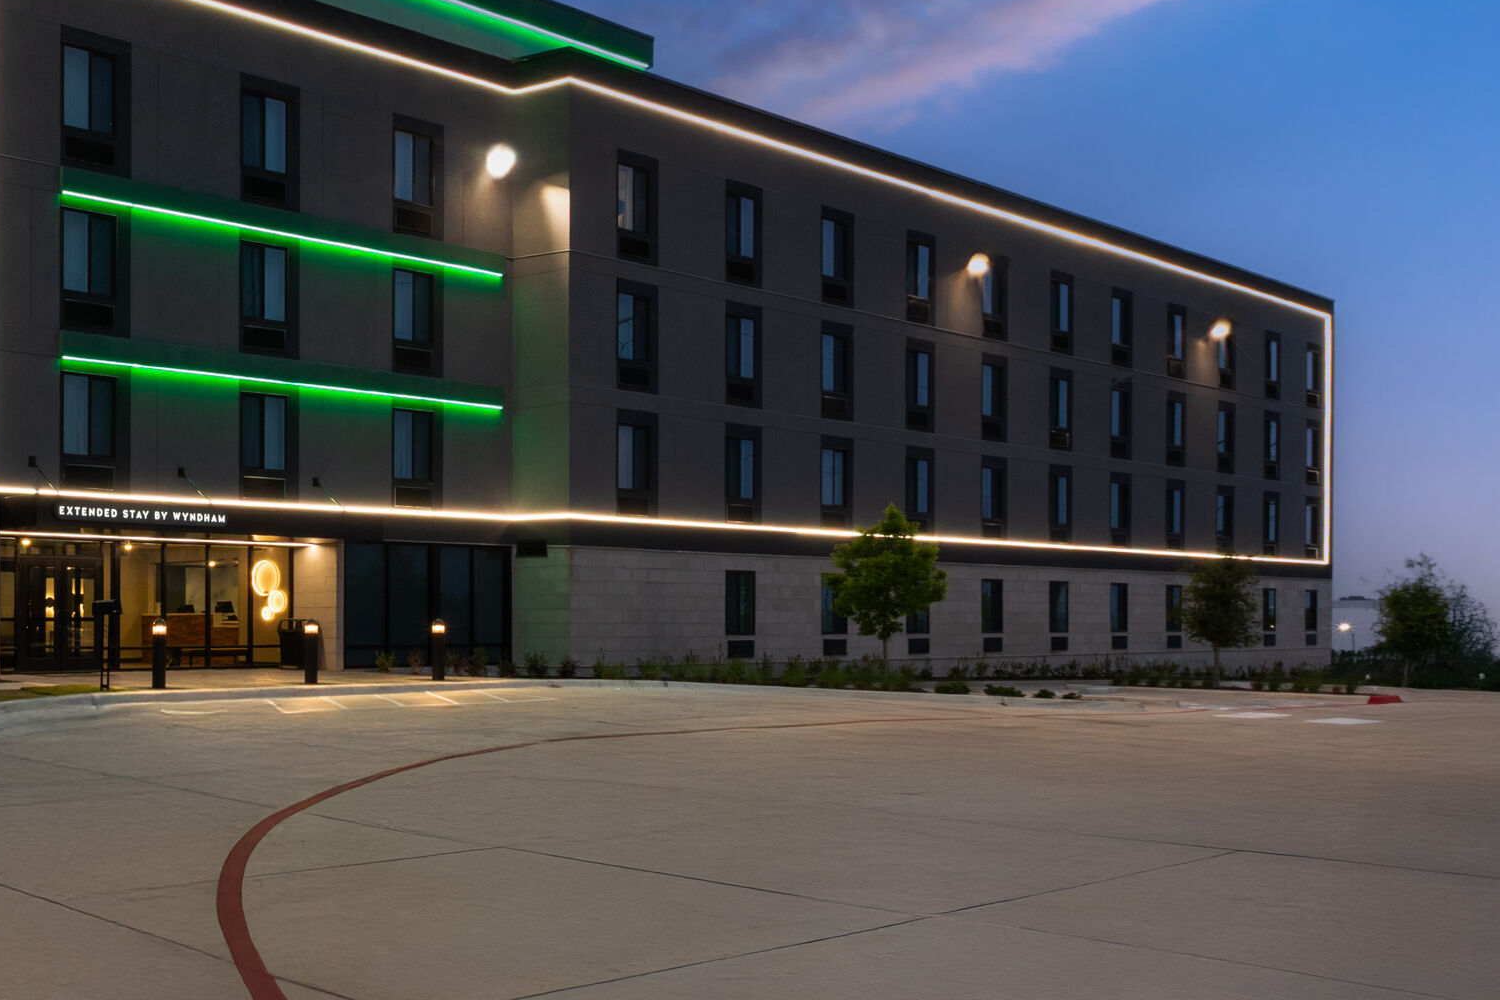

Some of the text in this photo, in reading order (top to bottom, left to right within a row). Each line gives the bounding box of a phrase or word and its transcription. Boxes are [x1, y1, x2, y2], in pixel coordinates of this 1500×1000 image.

[58, 505, 226, 523] EXTENDED STAY BY WYNDHAM
